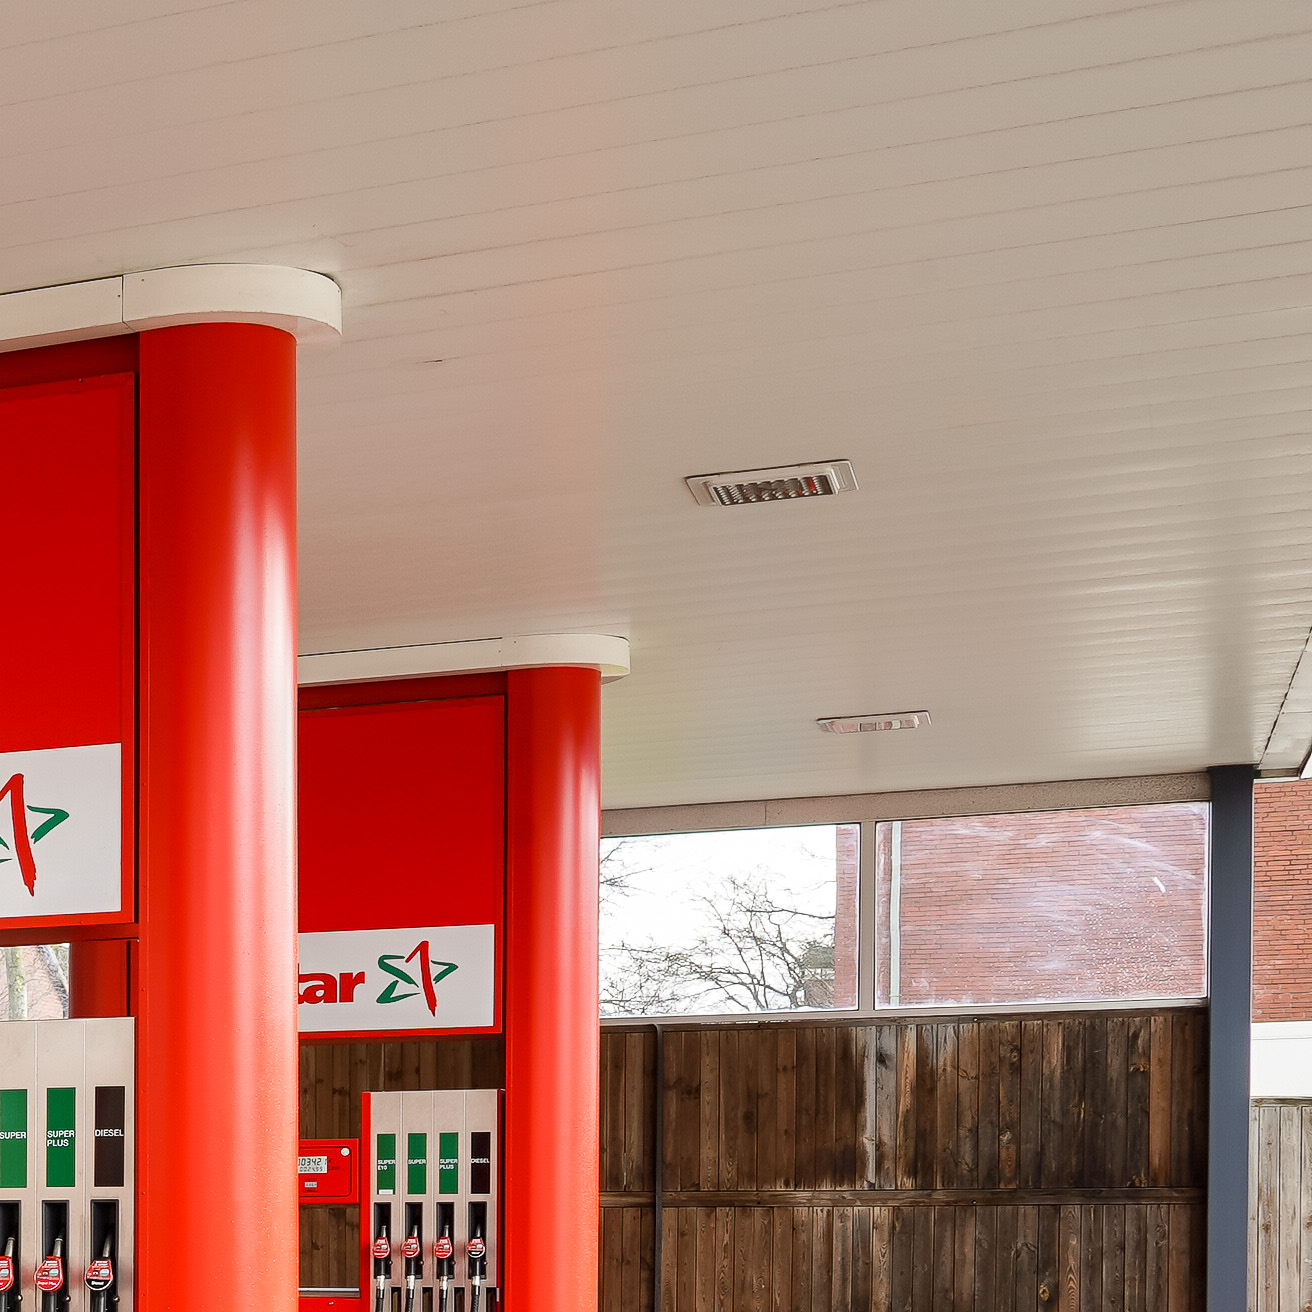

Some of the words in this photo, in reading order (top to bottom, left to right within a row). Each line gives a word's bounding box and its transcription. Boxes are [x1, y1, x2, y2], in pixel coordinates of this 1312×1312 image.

[0, 1131, 26, 1140] SUPER
[47, 1130, 75, 1138] SUPER
[95, 1128, 124, 1137] DIESEL
[47, 1139, 69, 1147] PLUS
